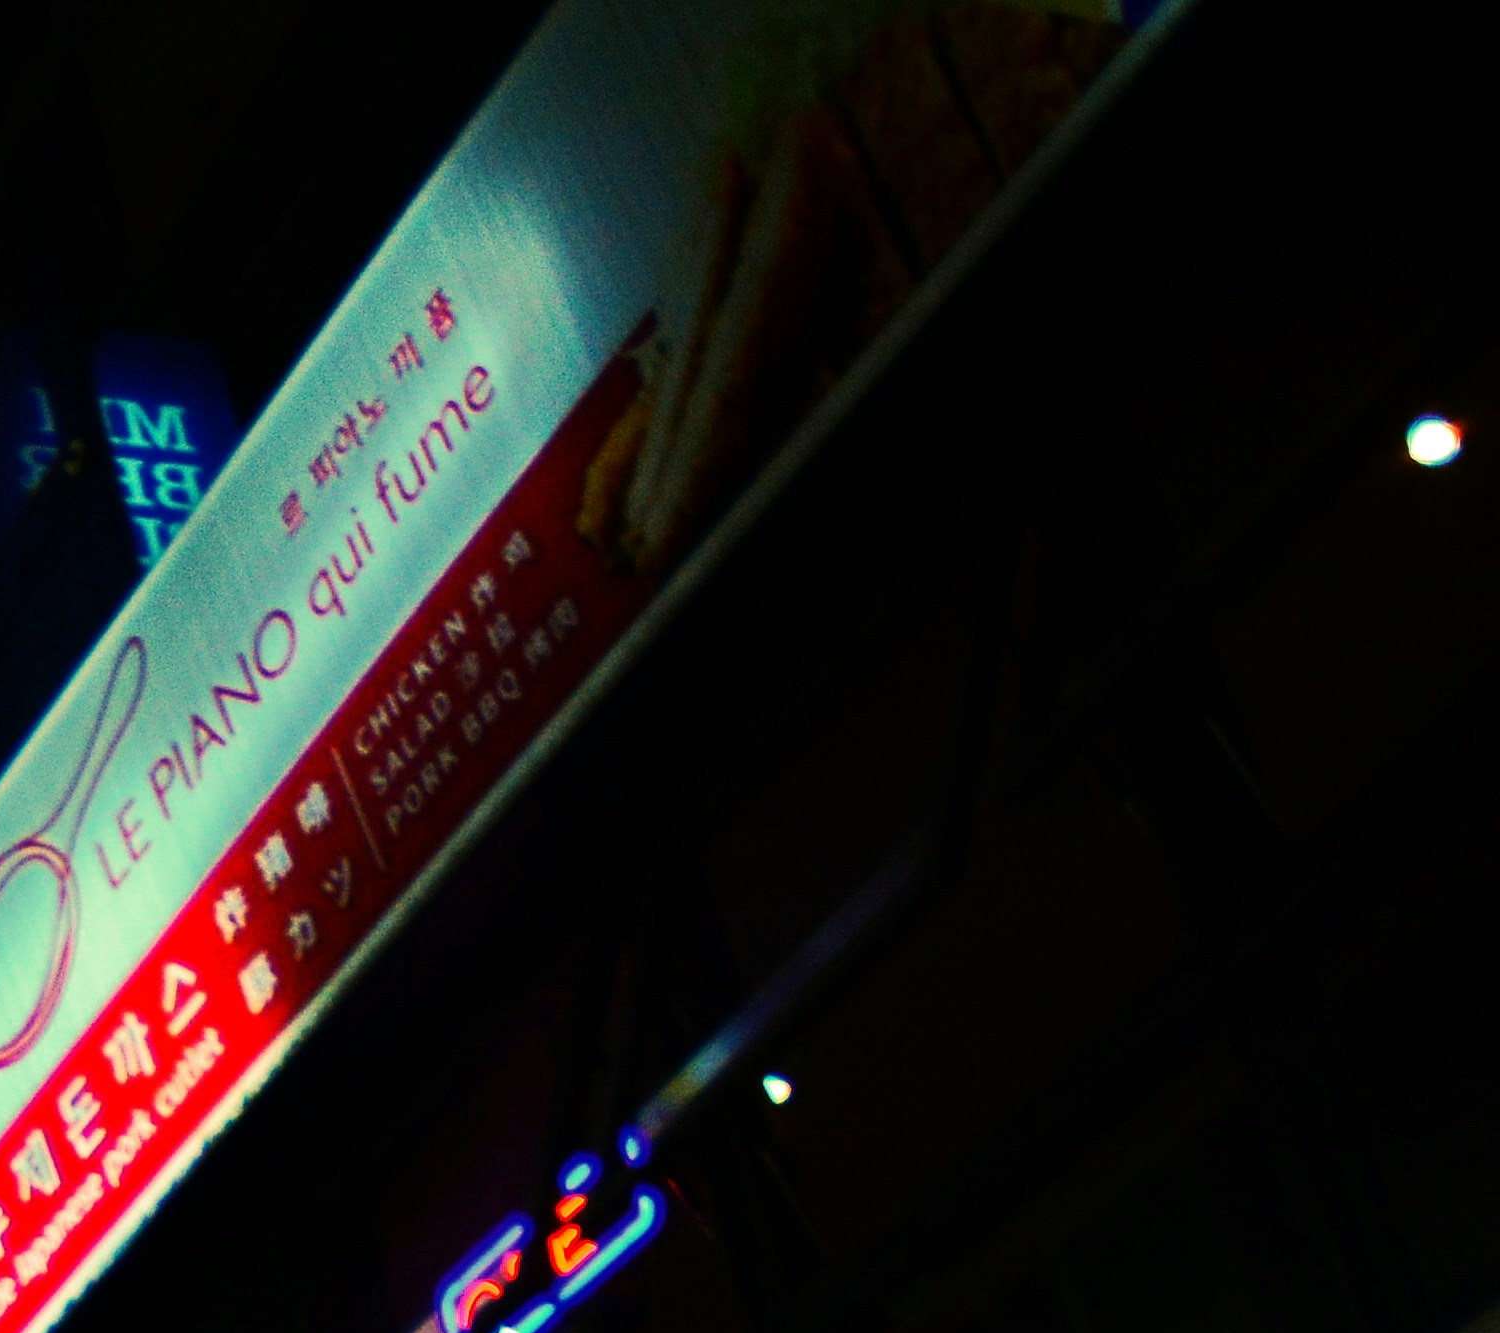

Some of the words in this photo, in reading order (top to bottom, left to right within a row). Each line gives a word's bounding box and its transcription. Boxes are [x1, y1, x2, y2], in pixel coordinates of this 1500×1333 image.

[92, 797, 153, 890] LE
[148, 607, 298, 821] PIANO
[307, 507, 377, 619] qui
[373, 362, 496, 526] fume
